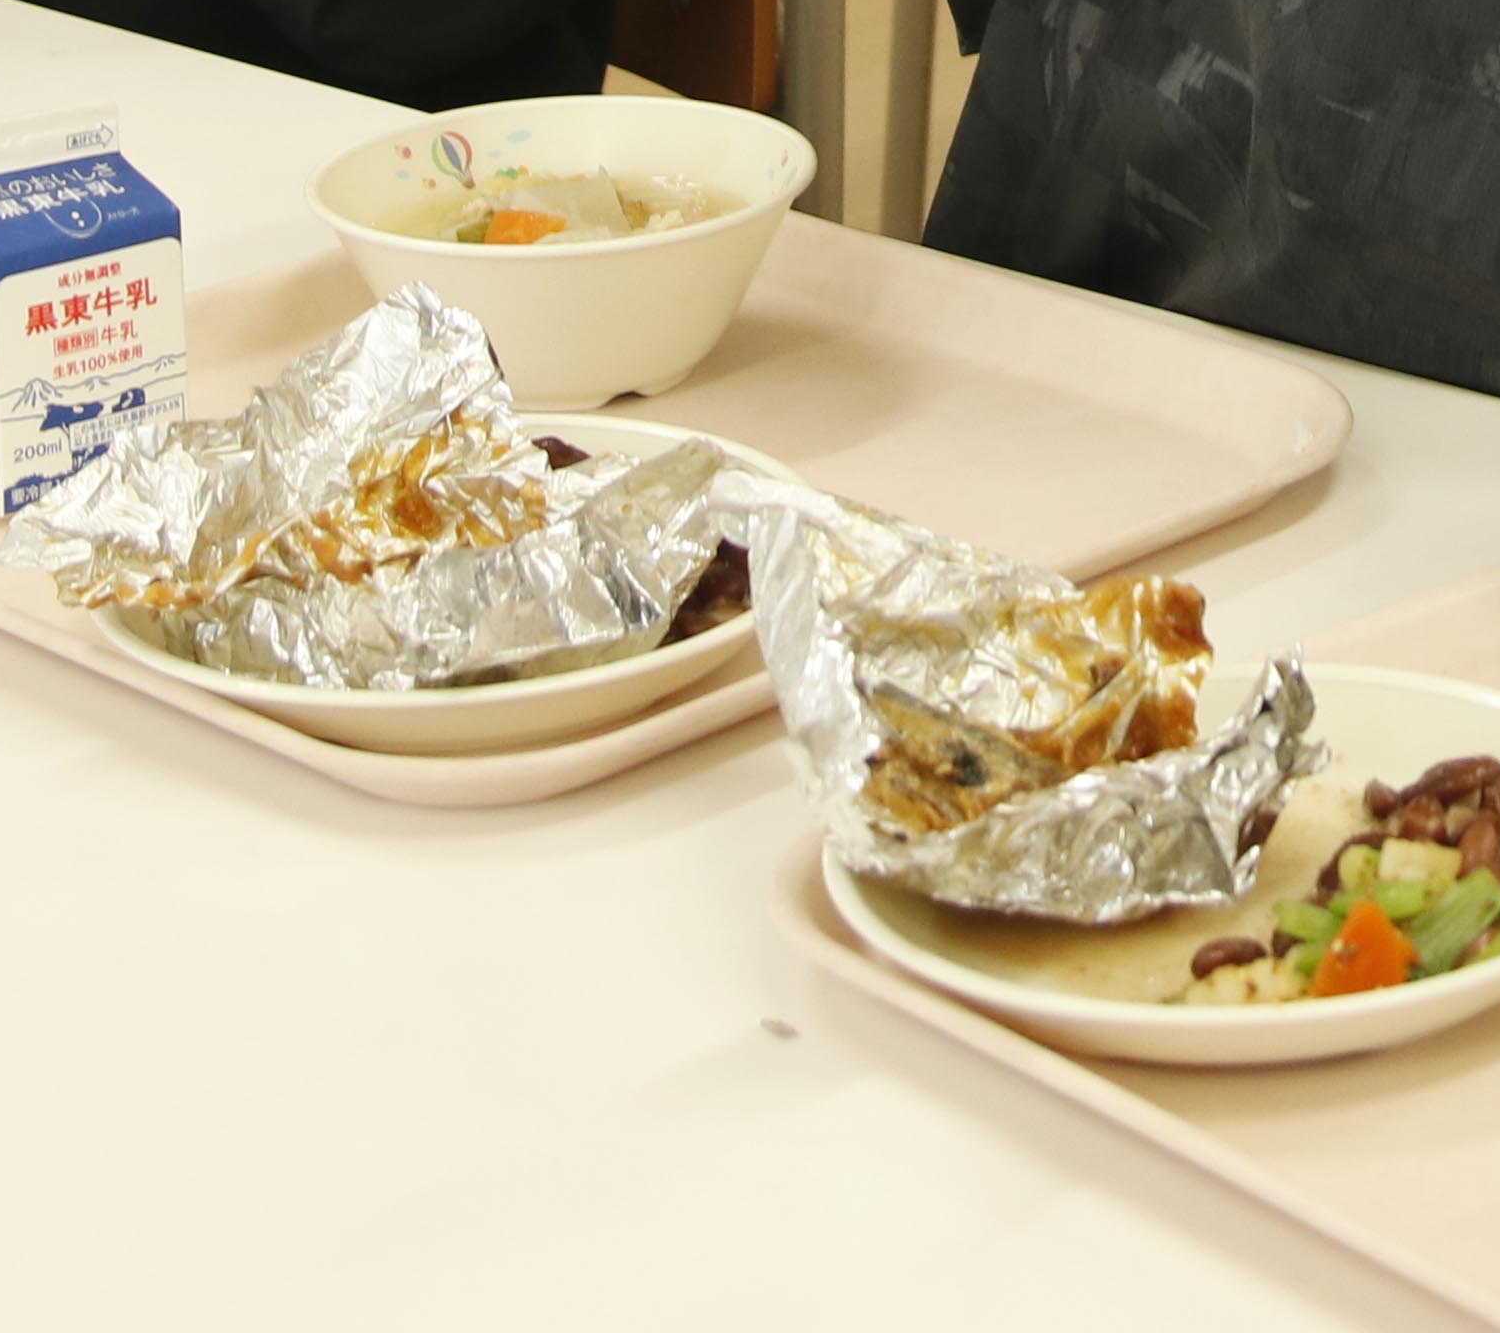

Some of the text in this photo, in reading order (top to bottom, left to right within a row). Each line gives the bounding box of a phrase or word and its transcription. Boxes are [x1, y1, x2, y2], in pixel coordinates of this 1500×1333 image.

[58, 262, 121, 288] 成分無調整
[26, 276, 158, 337] 黒東牛乳
[13, 438, 62, 465] 200ml
